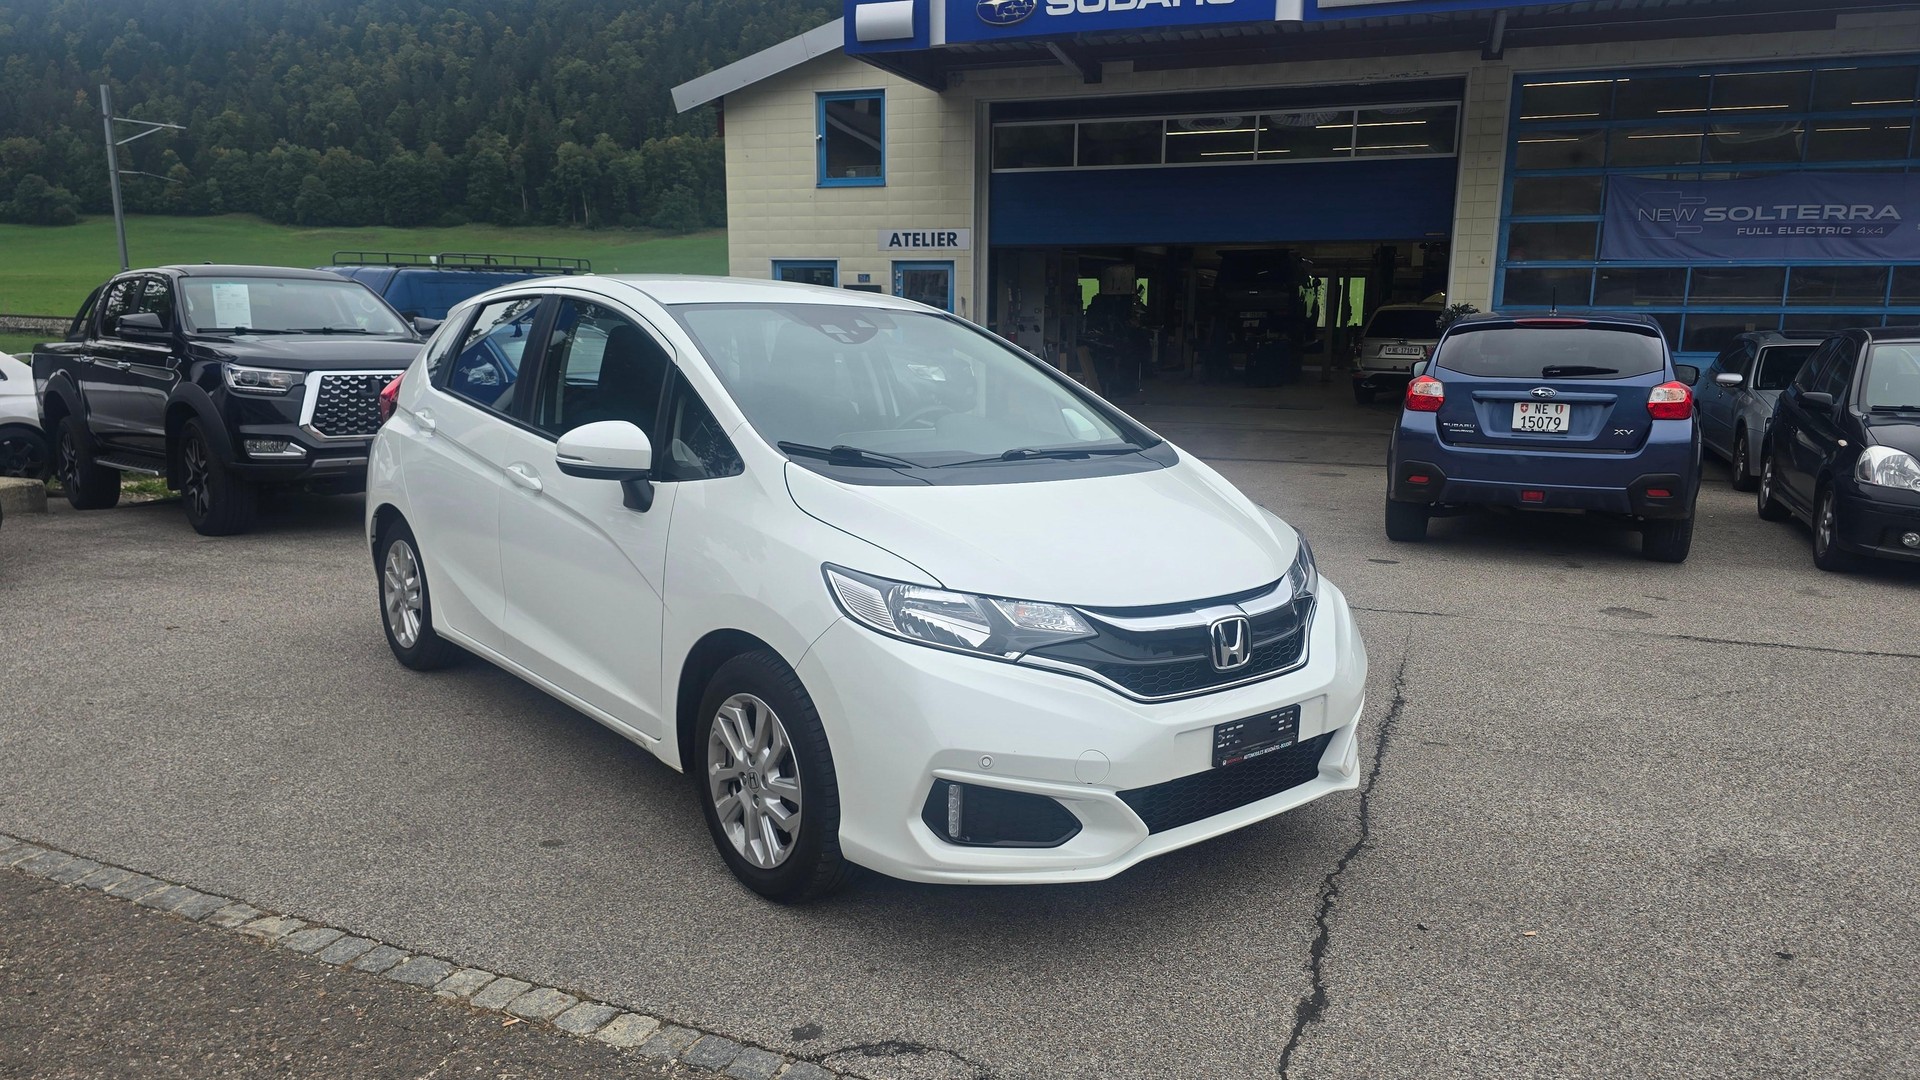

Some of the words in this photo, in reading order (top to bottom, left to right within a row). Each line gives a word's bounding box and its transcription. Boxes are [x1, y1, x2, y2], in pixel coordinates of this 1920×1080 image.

[1638, 207, 1697, 222] NEW
[1703, 204, 1902, 222] SOLTERRA
[1737, 227, 1773, 235] FULL
[1778, 226, 1852, 235] ELECTRIC
[1857, 226, 1884, 235] 4x4
[889, 232, 958, 247] ATELIER
[1534, 404, 1549, 415] NE
[1520, 415, 1561, 430] 15079
